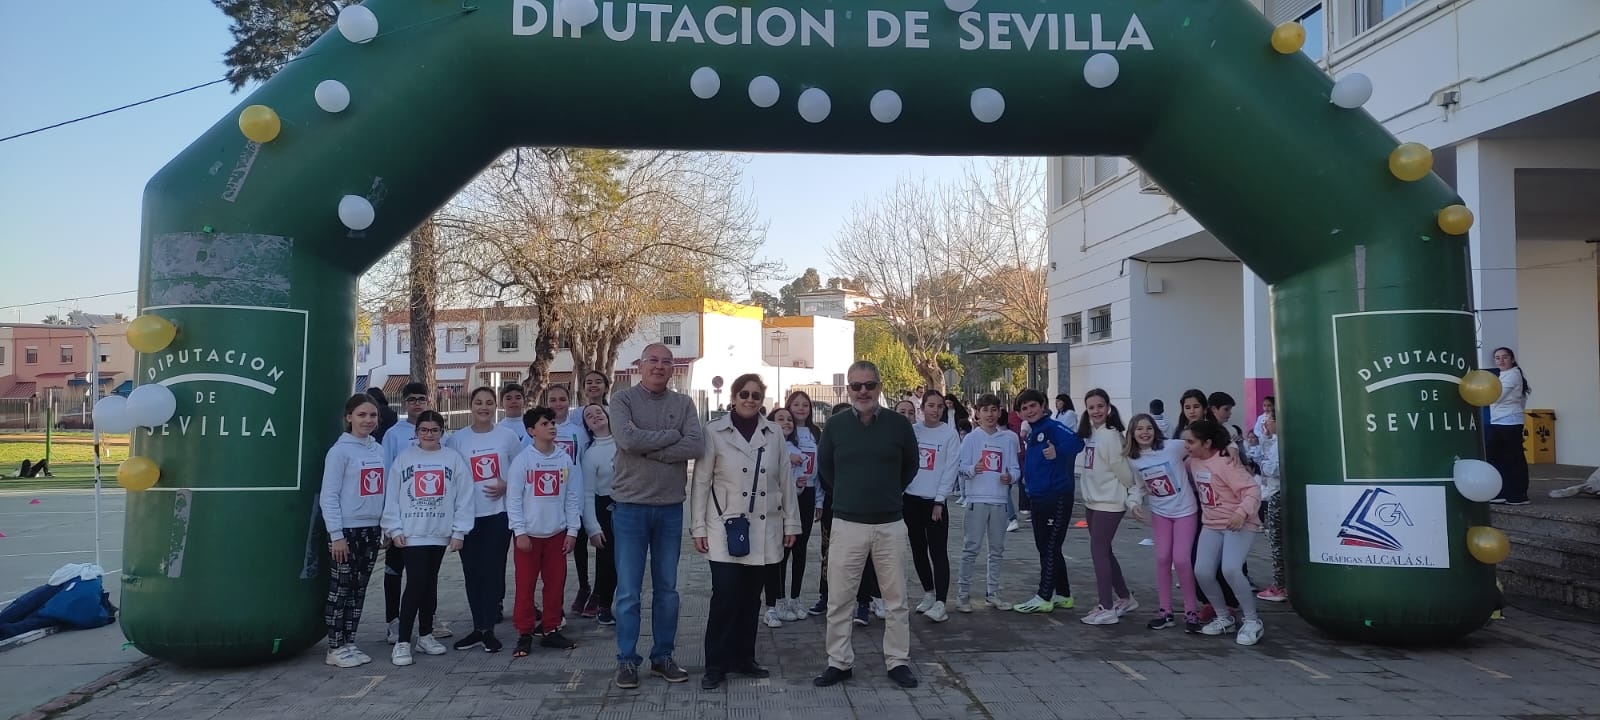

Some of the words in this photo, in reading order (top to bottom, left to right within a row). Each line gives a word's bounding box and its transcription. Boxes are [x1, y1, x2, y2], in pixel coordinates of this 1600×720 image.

[867, 10, 930, 48] DE
[959, 12, 1154, 51] SEVILLA
[147, 349, 285, 382] DIPUTACION
[1358, 350, 1472, 382] DIPUTACIO
[196, 391, 216, 404] DE
[1421, 389, 1439, 401] DE
[1366, 412, 1477, 432] SEVILLA
